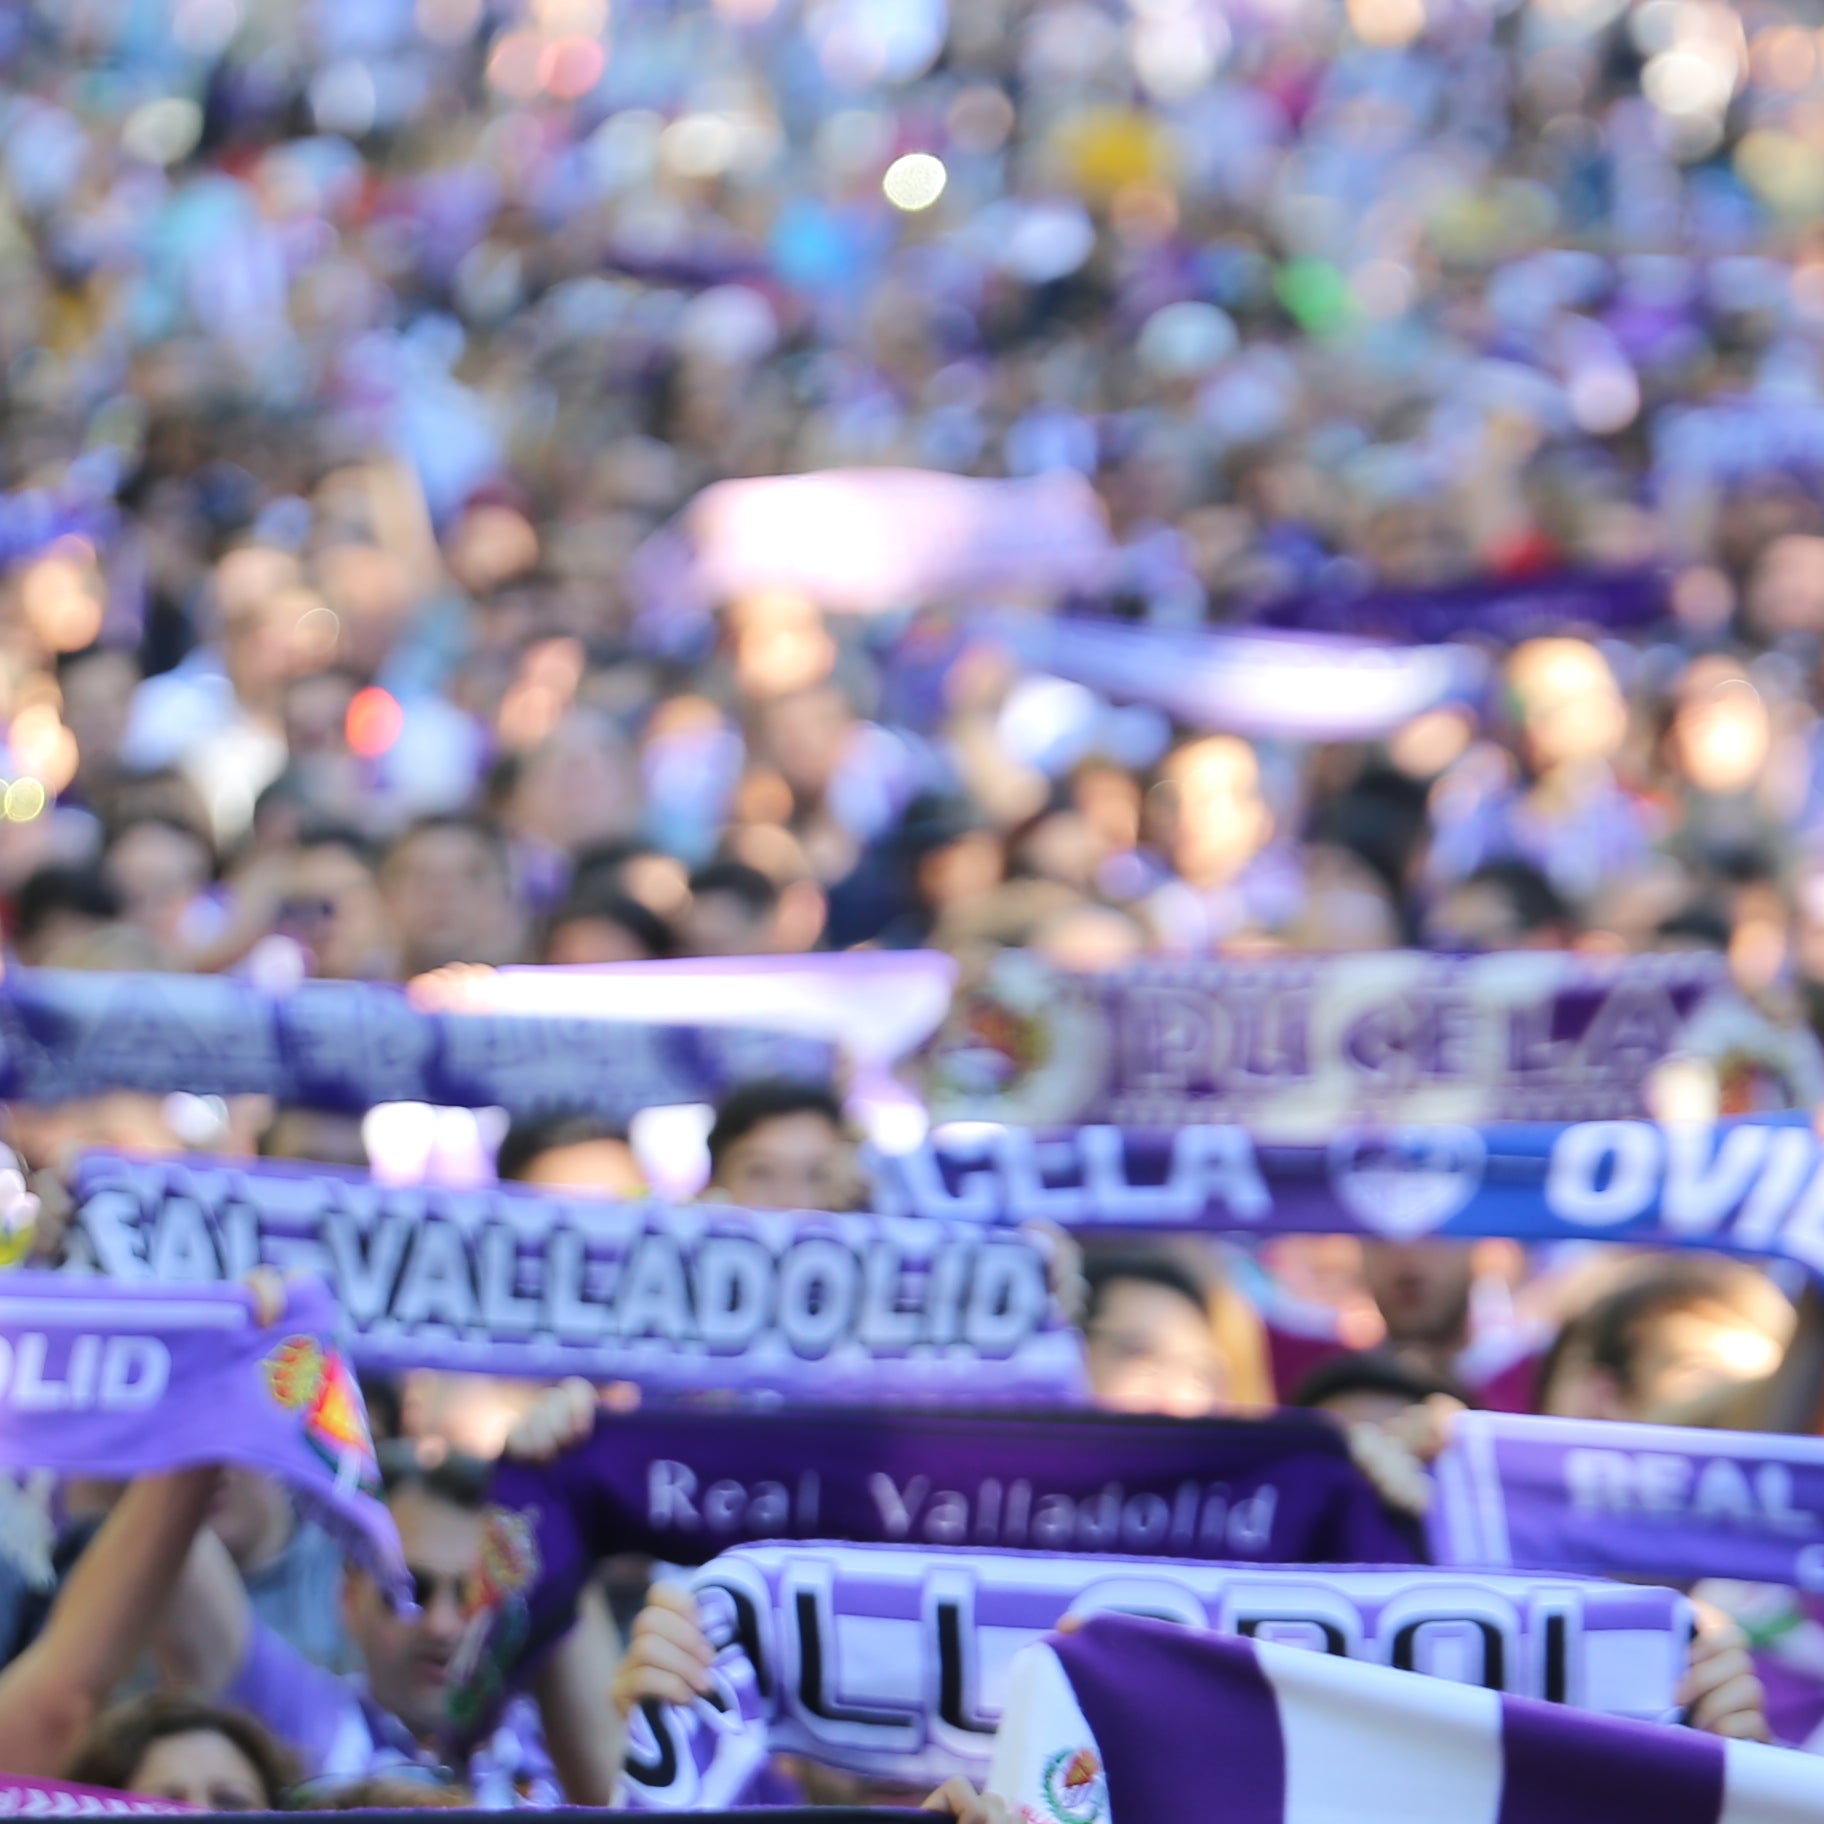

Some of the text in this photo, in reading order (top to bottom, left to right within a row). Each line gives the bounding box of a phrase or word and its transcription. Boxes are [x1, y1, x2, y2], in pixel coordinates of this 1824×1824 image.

[322, 1206, 1049, 1359] VALLADOLID
[648, 1457, 1277, 1551] Real Valladolid
[1566, 1450, 1821, 1535] REAL
